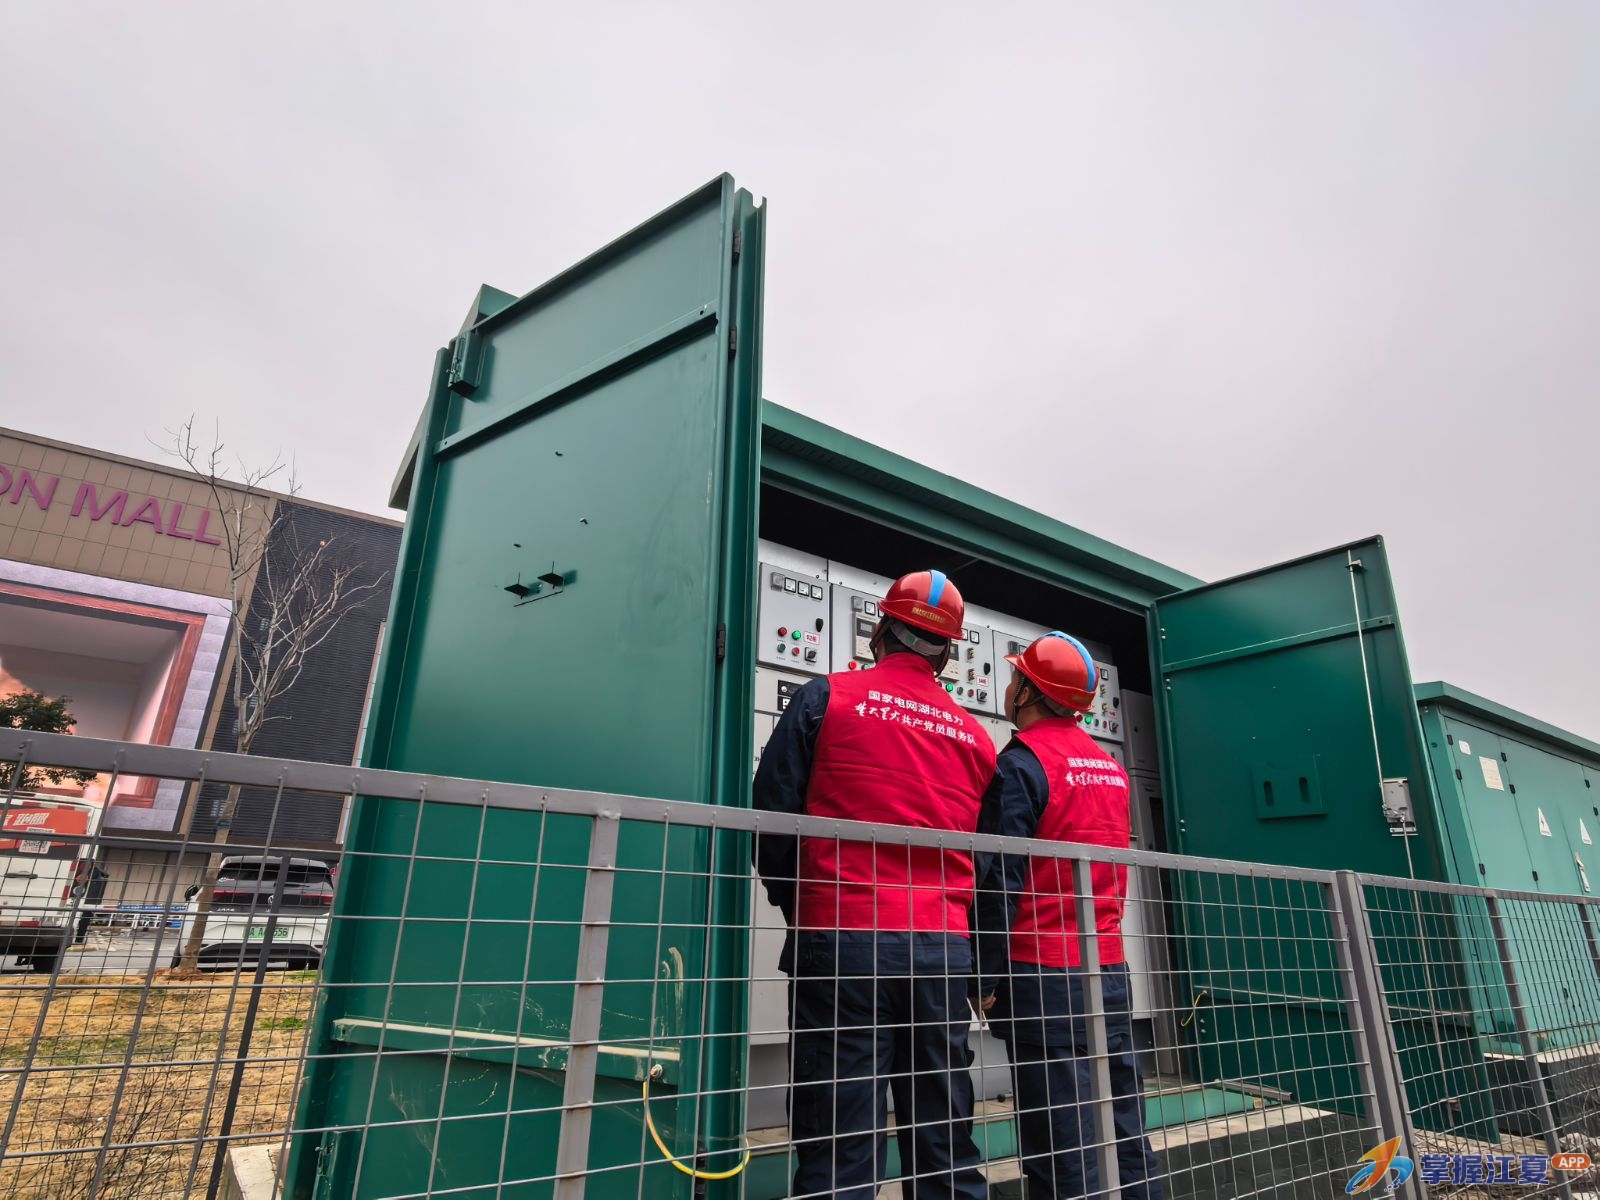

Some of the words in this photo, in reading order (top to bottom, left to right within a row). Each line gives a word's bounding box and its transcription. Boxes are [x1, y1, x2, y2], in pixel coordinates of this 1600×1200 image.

[70, 483, 221, 546] MALL
[868, 690, 964, 726] 国家电网湖北电力
